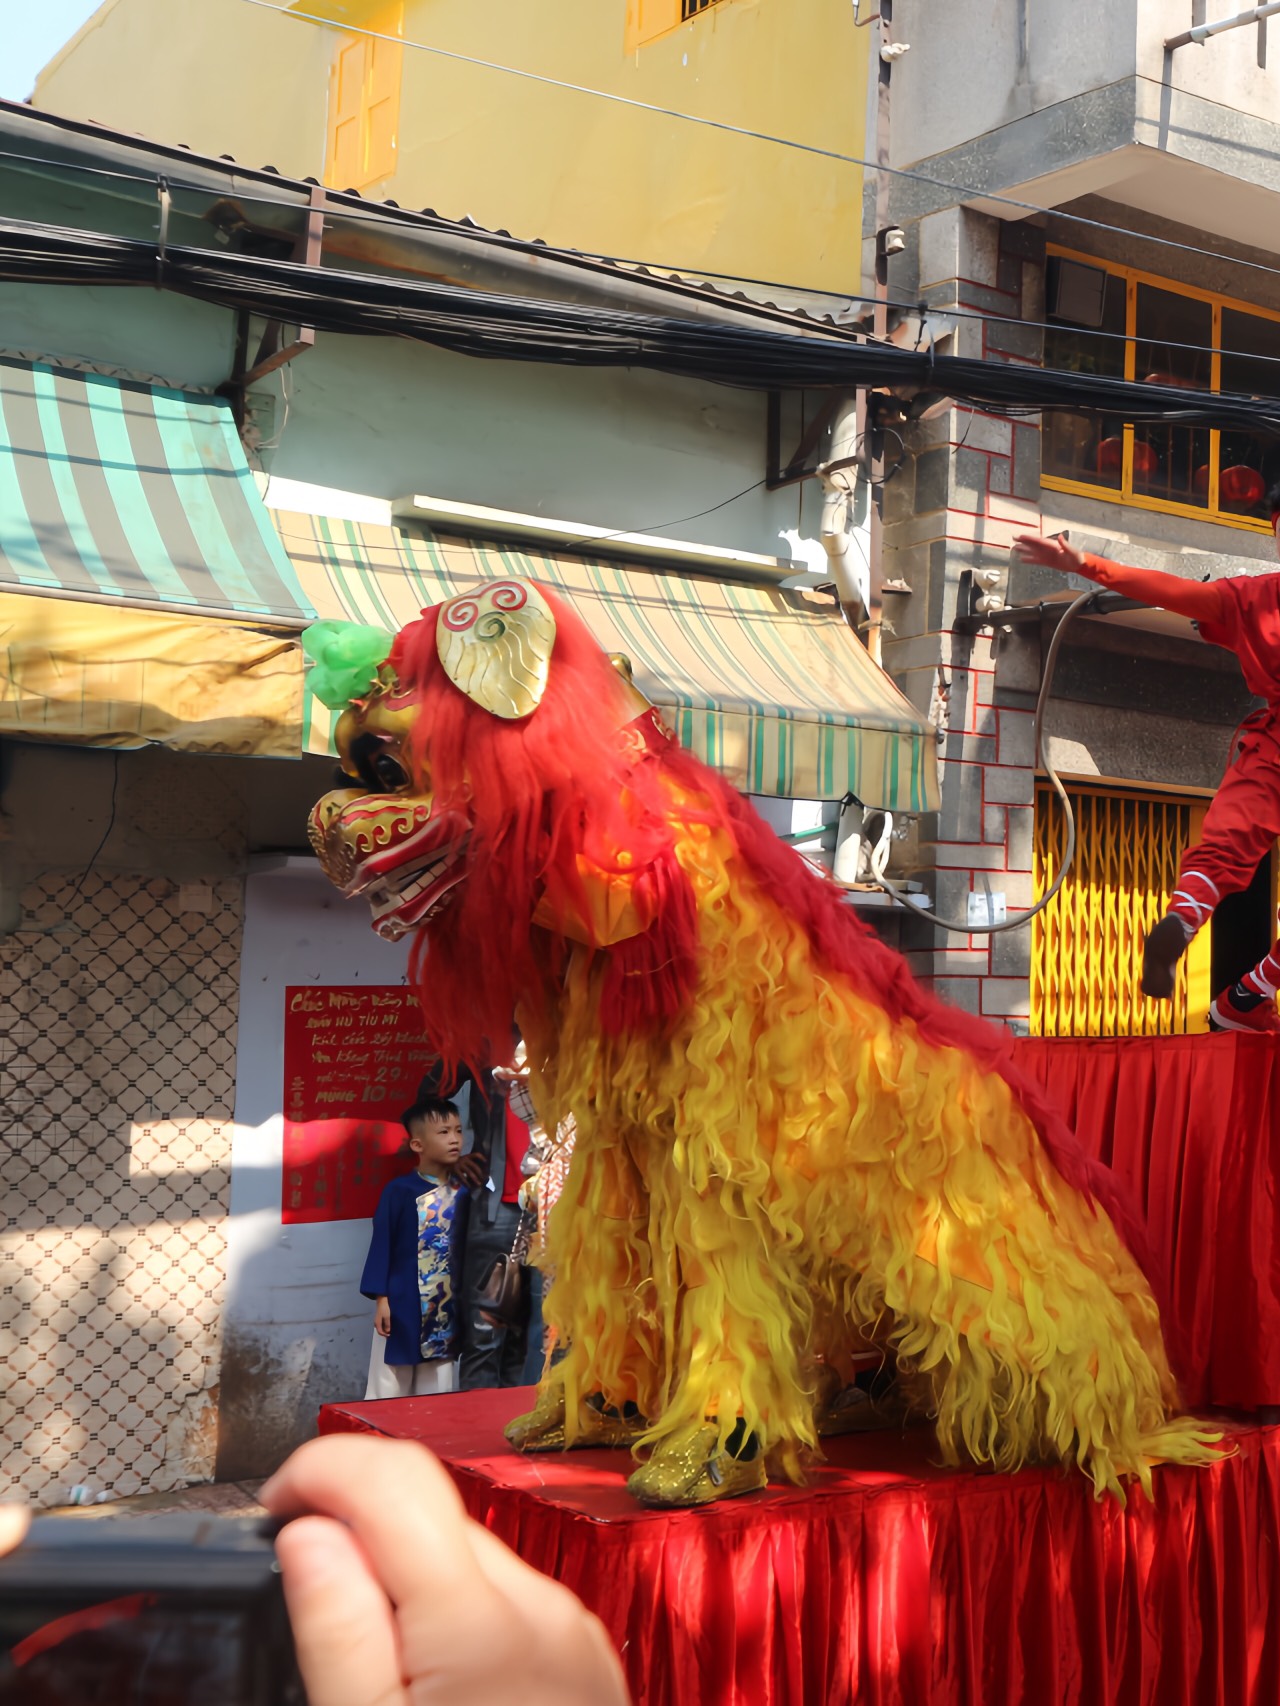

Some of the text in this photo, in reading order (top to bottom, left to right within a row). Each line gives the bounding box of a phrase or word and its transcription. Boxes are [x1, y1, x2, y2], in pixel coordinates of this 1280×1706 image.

[406, 994, 419, 1008] M
[375, 1067, 401, 1082] 29
[361, 1085, 387, 1102] 10
